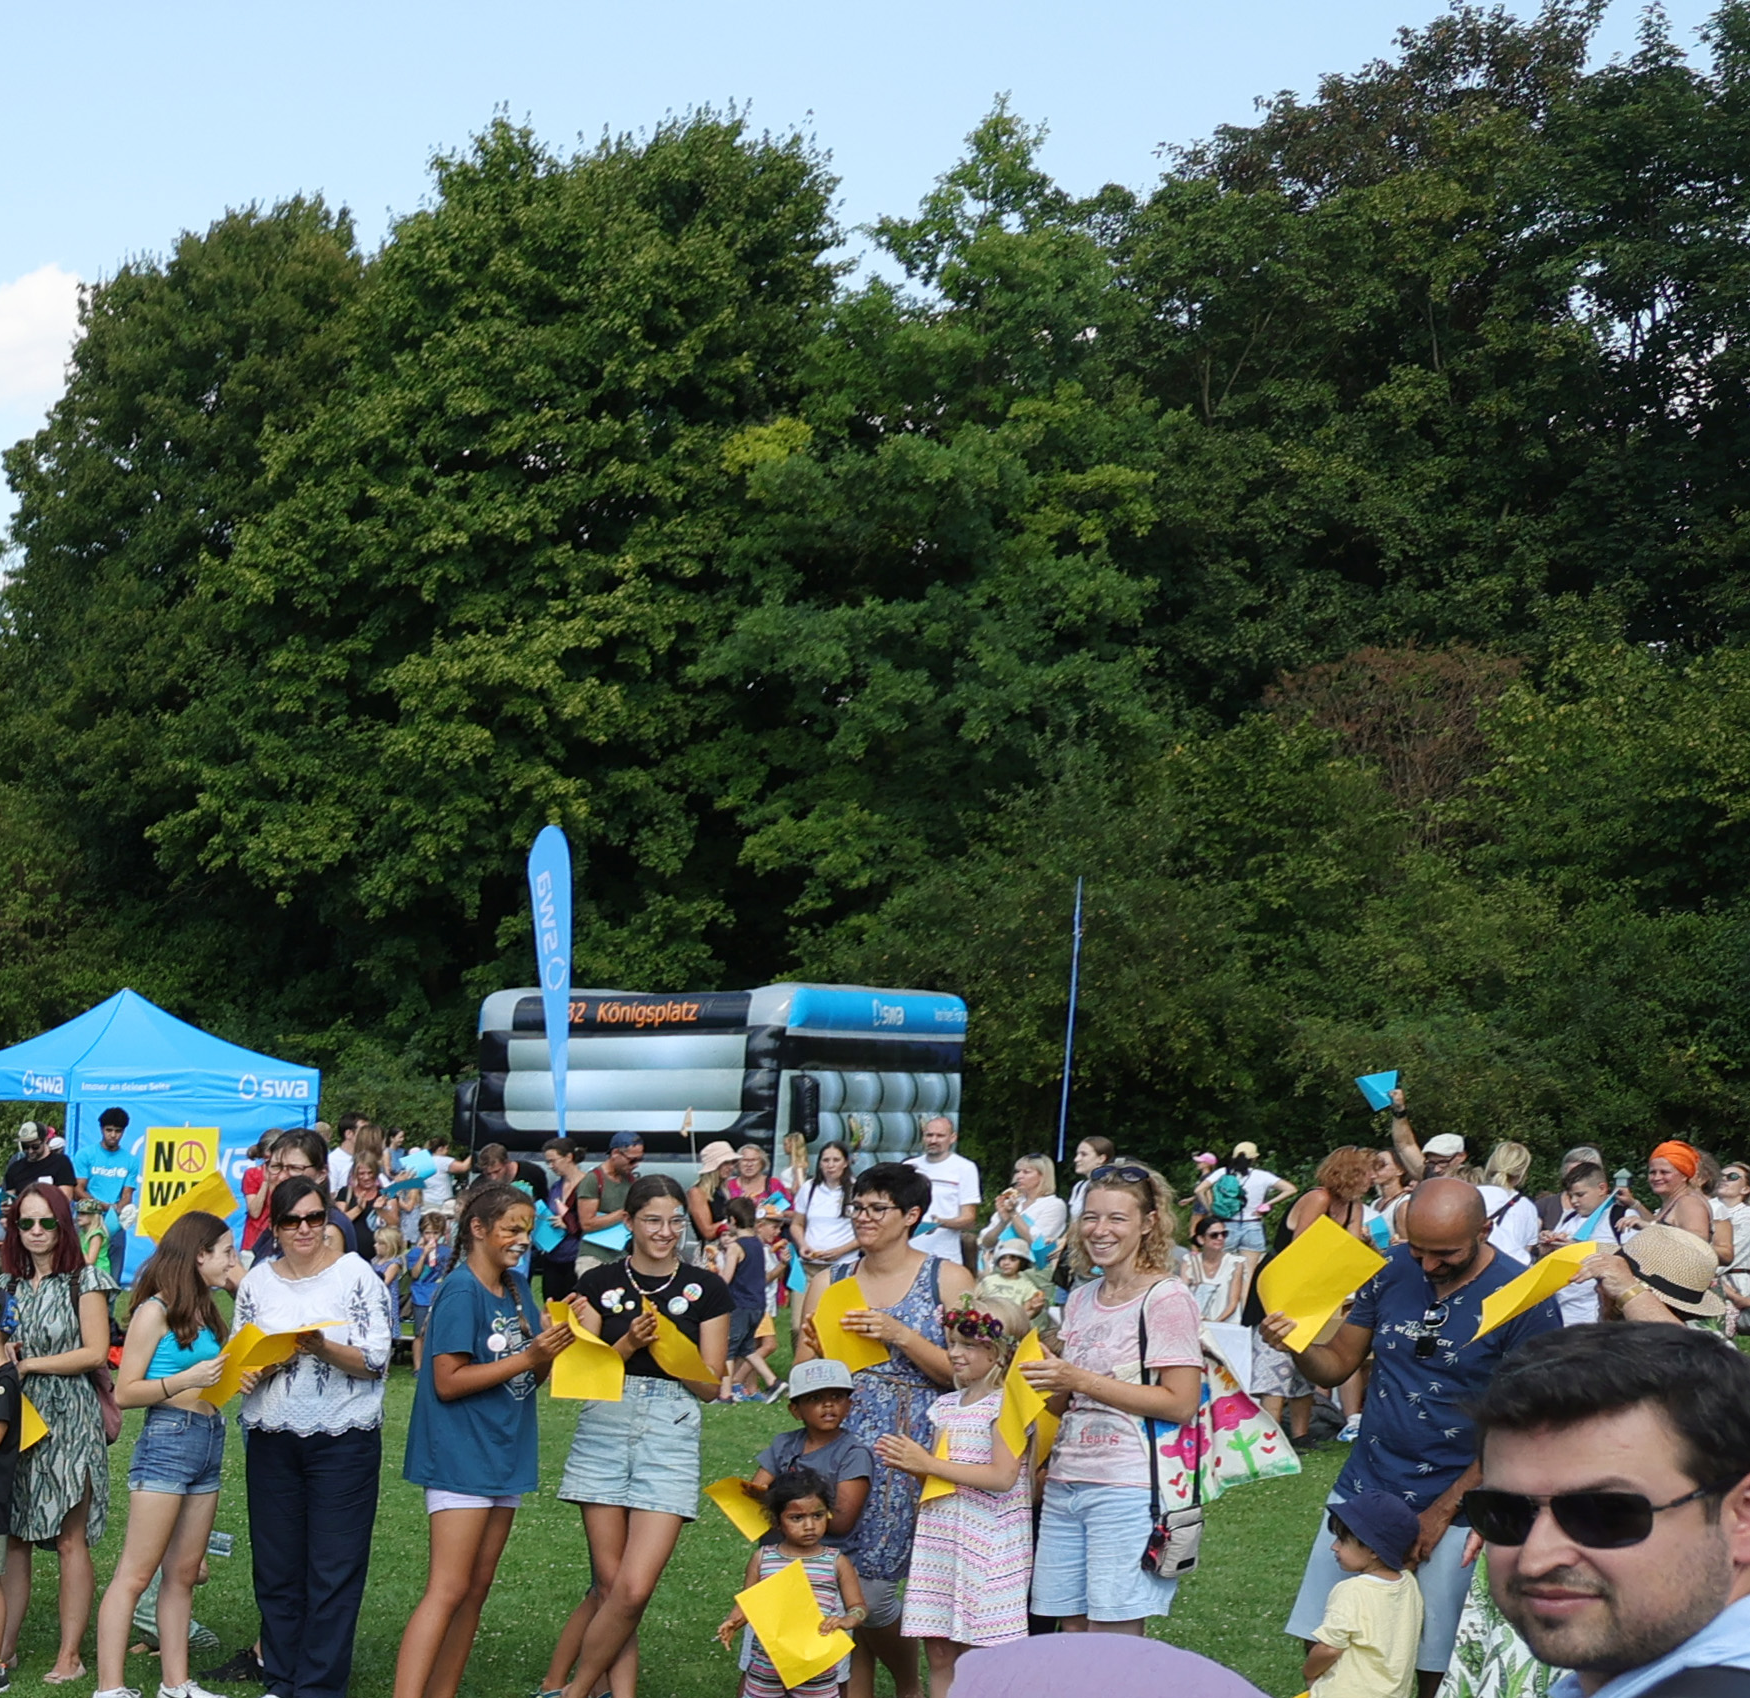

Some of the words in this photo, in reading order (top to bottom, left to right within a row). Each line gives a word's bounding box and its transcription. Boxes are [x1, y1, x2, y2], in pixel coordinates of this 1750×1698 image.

[596, 1000, 700, 1029] Königsplatz
[35, 1075, 64, 1095] swa
[261, 1079, 309, 1098] swa
[91, 1165, 118, 1178] unicef
[149, 1181, 201, 1207] WA
